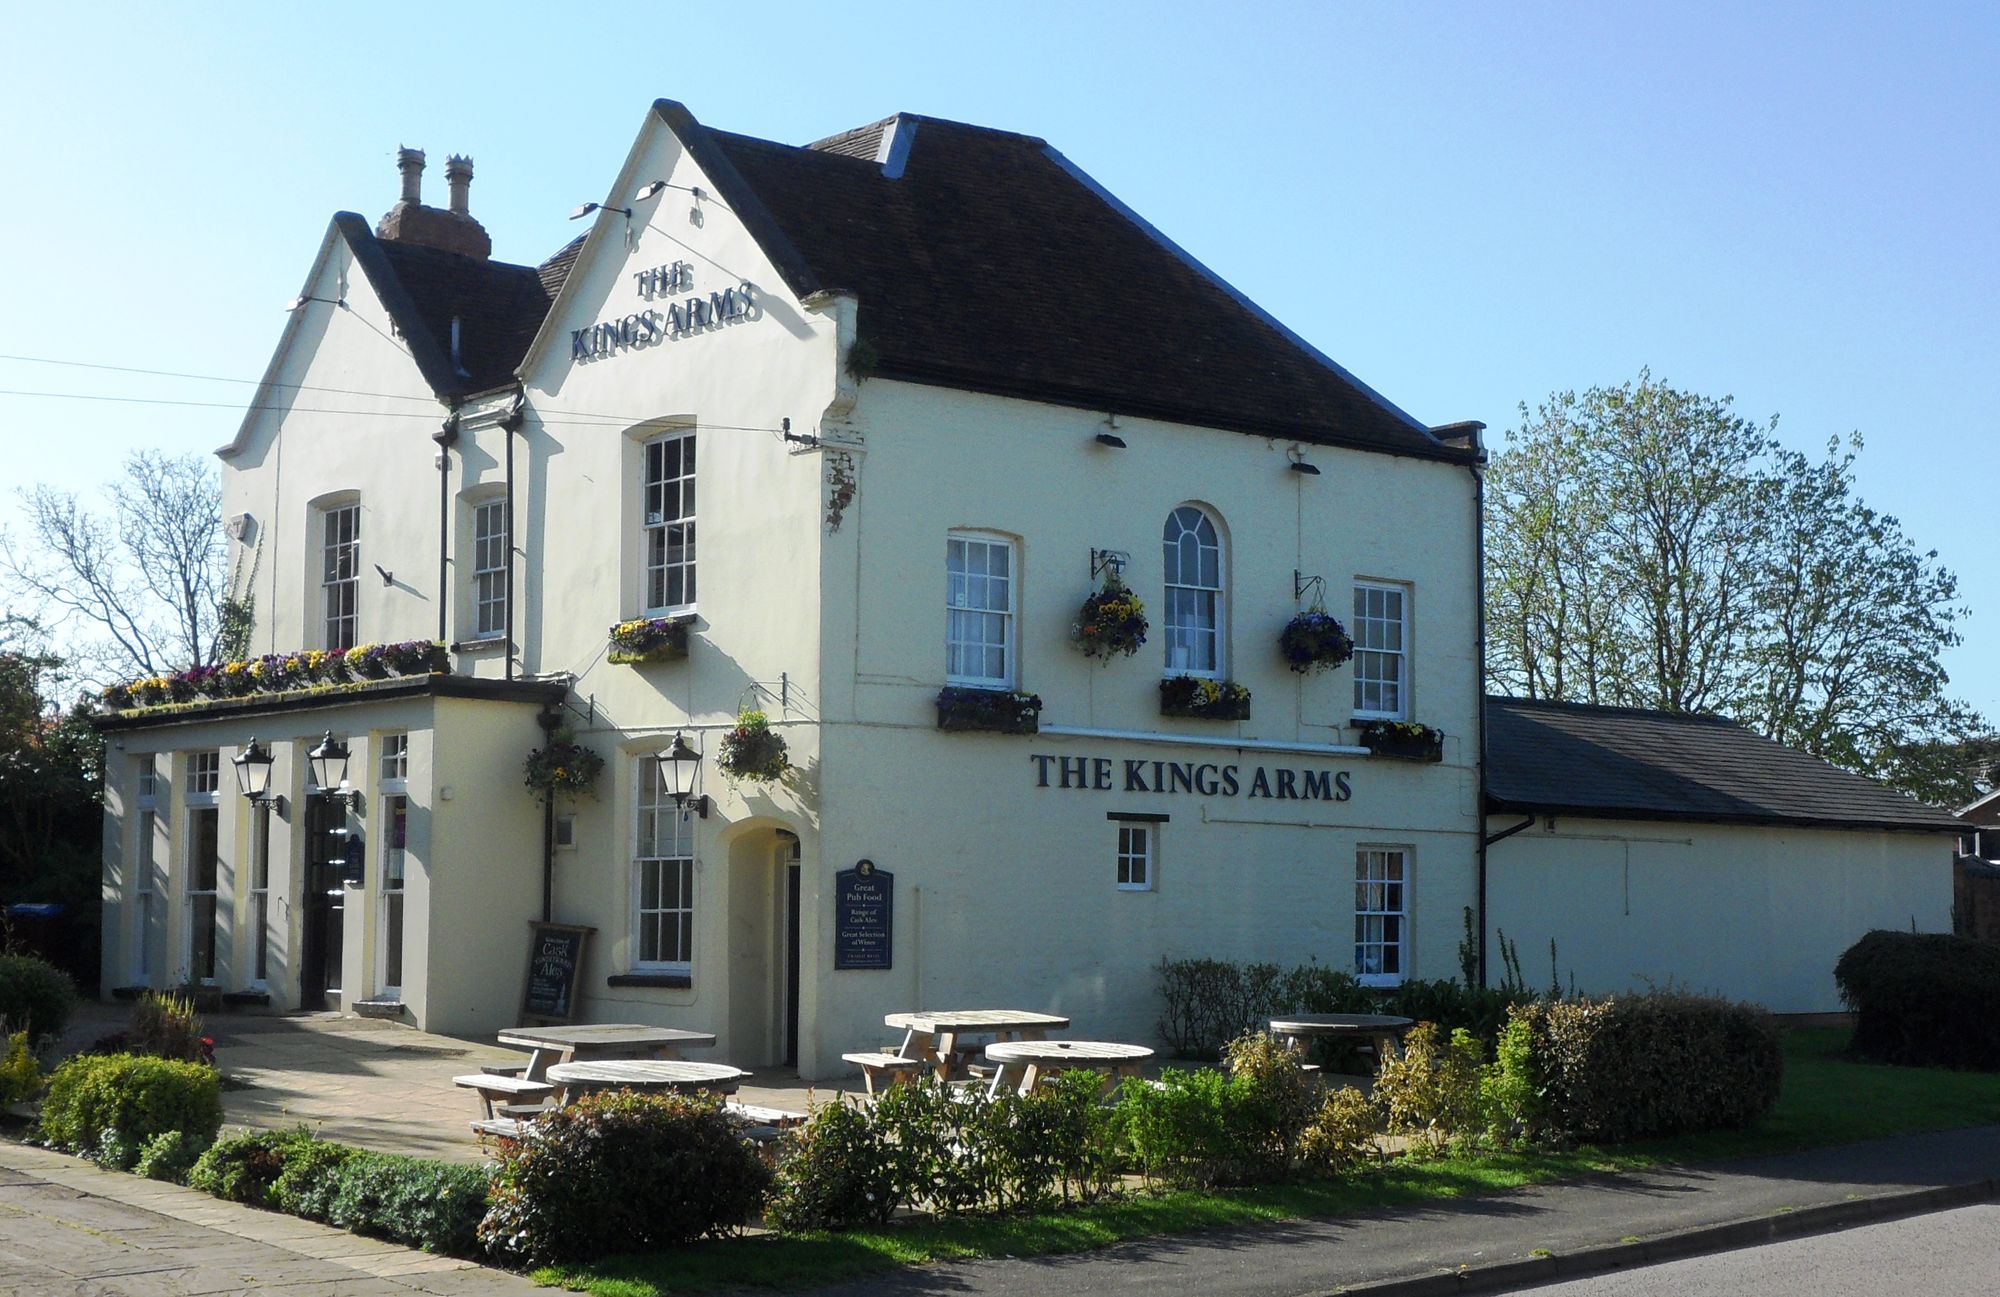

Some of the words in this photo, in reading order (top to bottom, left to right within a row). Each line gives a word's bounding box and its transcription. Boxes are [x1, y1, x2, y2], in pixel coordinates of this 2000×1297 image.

[633, 260, 684, 297] THE
[569, 308, 656, 361] KINGS
[663, 280, 753, 337] ARMS
[1031, 754, 1112, 791] THE
[1123, 759, 1240, 797] KINGS
[1248, 766, 1352, 802] ARMS
[853, 883, 875, 891] Great
[846, 893, 862, 901] Pub
[863, 893, 882, 901] Food
[851, 909, 869, 917] Range
[542, 942, 568, 957] Cask
[540, 961, 563, 977] Ales
